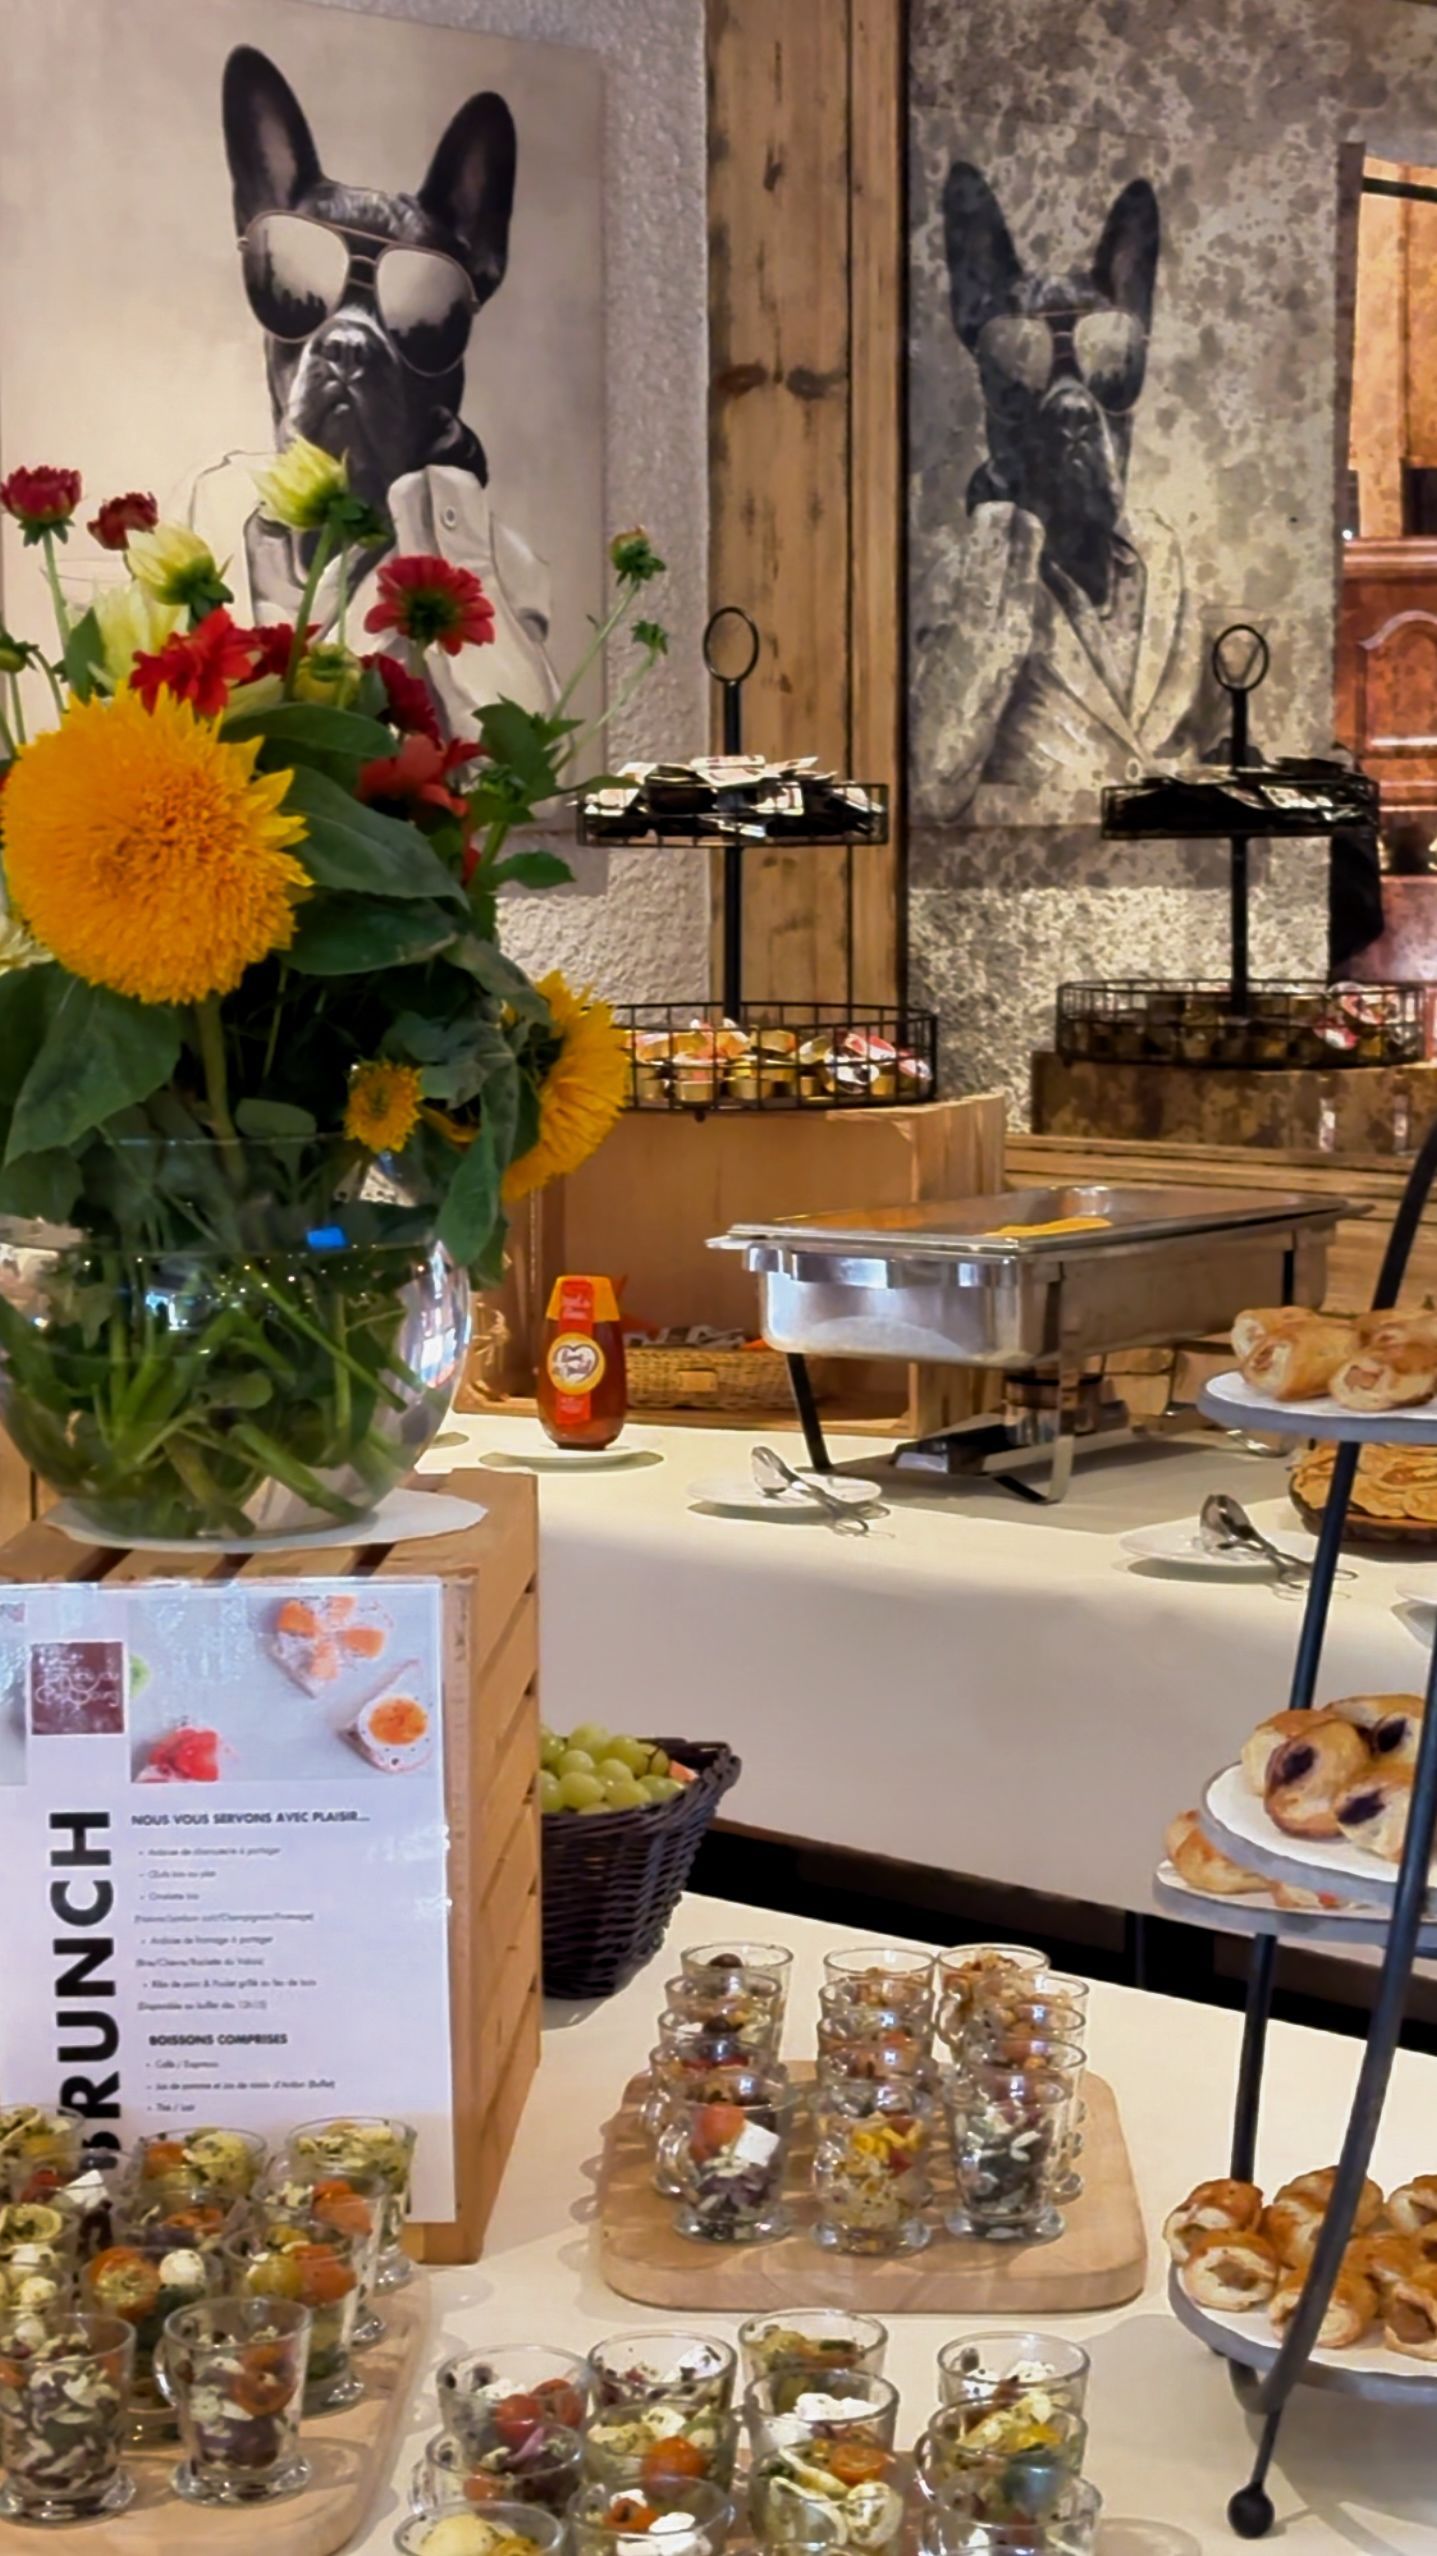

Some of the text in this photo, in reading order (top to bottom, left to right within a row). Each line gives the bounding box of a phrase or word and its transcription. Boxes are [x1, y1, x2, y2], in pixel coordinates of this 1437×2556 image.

[131, 1814, 170, 1826] NOUS
[174, 1813, 210, 1825] VOUS
[213, 1812, 272, 1824] SERVONS
[276, 1812, 309, 1823] AVEC
[148, 2033, 288, 2046] BOISSONS COMPRISES
